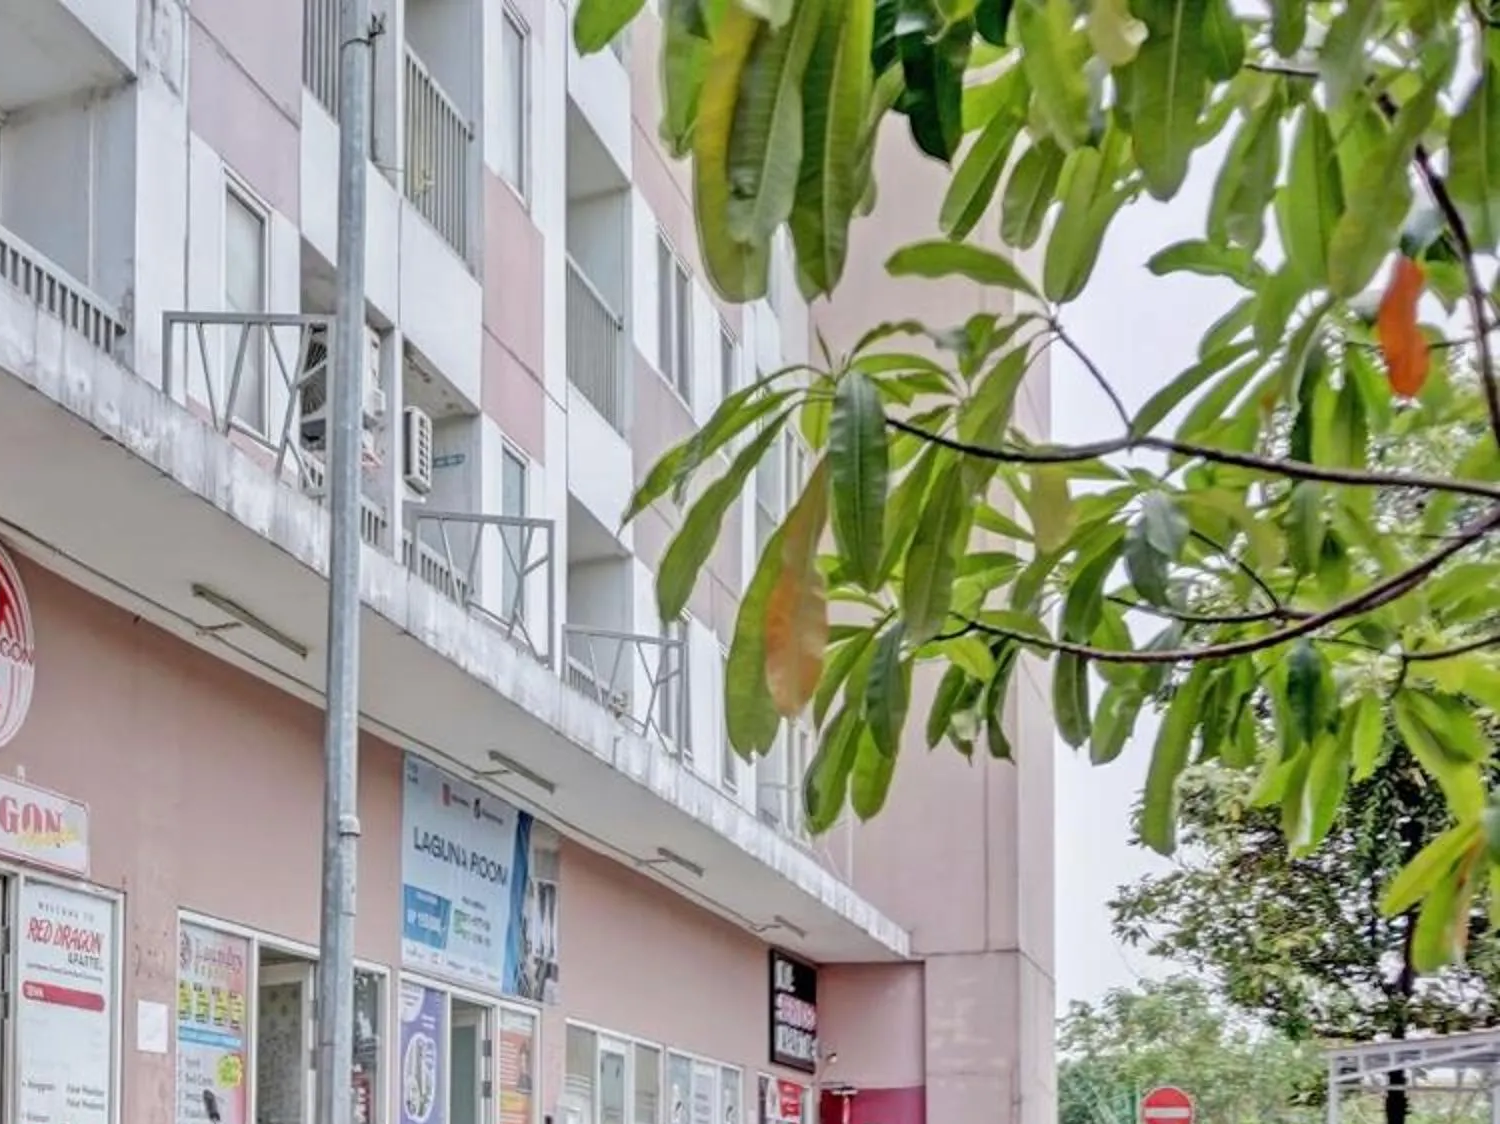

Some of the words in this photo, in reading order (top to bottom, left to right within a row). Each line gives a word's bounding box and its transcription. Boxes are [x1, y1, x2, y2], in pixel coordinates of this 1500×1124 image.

[413, 826, 467, 871] LAGUNA
[470, 851, 509, 886] ROOM
[27, 917, 53, 944] RED
[53, 924, 103, 955] DRAGON
